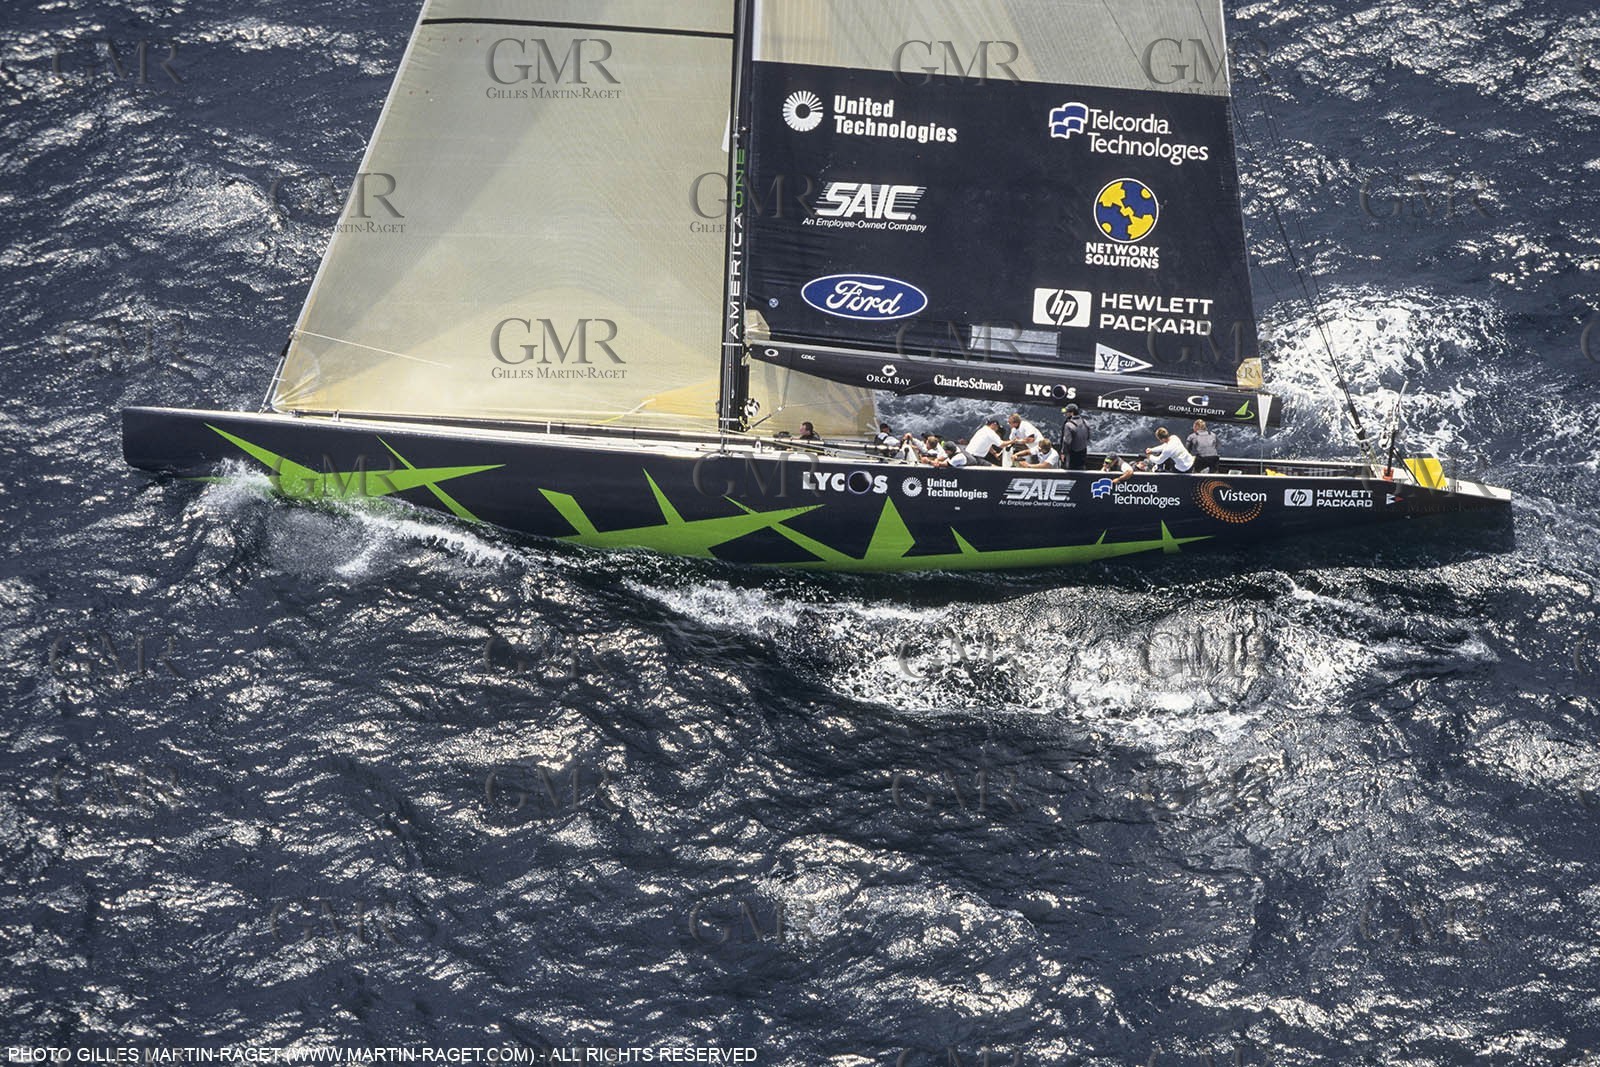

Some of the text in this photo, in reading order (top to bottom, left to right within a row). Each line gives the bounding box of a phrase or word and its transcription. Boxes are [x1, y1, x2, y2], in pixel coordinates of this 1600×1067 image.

[834, 95, 894, 118] United
[834, 115, 957, 144] Technologies
[1087, 132, 1208, 165] Technologies
[815, 182, 922, 220] SAIC
[802, 217, 927, 232] An Employee-Owned Company
[729, 149, 745, 339] AMERICA ONE
[1085, 242, 1159, 258] NETWORK
[1085, 254, 1159, 269] SOLUTIONS
[825, 280, 904, 315] Ford
[1101, 292, 1213, 315] HEWLETT
[1049, 290, 1077, 325] hp
[1100, 314, 1212, 336] PACKARD
[866, 374, 911, 386] ORCA BAY
[1025, 383, 1077, 399] LYCOS
[1168, 405, 1191, 413] GLOBAL
[1193, 407, 1226, 416] INTEGRITY
[802, 471, 888, 494] LYCOS
[926, 478, 957, 489] United
[1003, 478, 1074, 501] SAIC
[926, 487, 988, 500] Technologies
[1112, 493, 1180, 508] Technologies
[1219, 489, 1267, 502] Visteon
[1290, 490, 1307, 506] hp
[1316, 489, 1373, 499] HEWLETT
[1316, 498, 1373, 508] PACKARD
